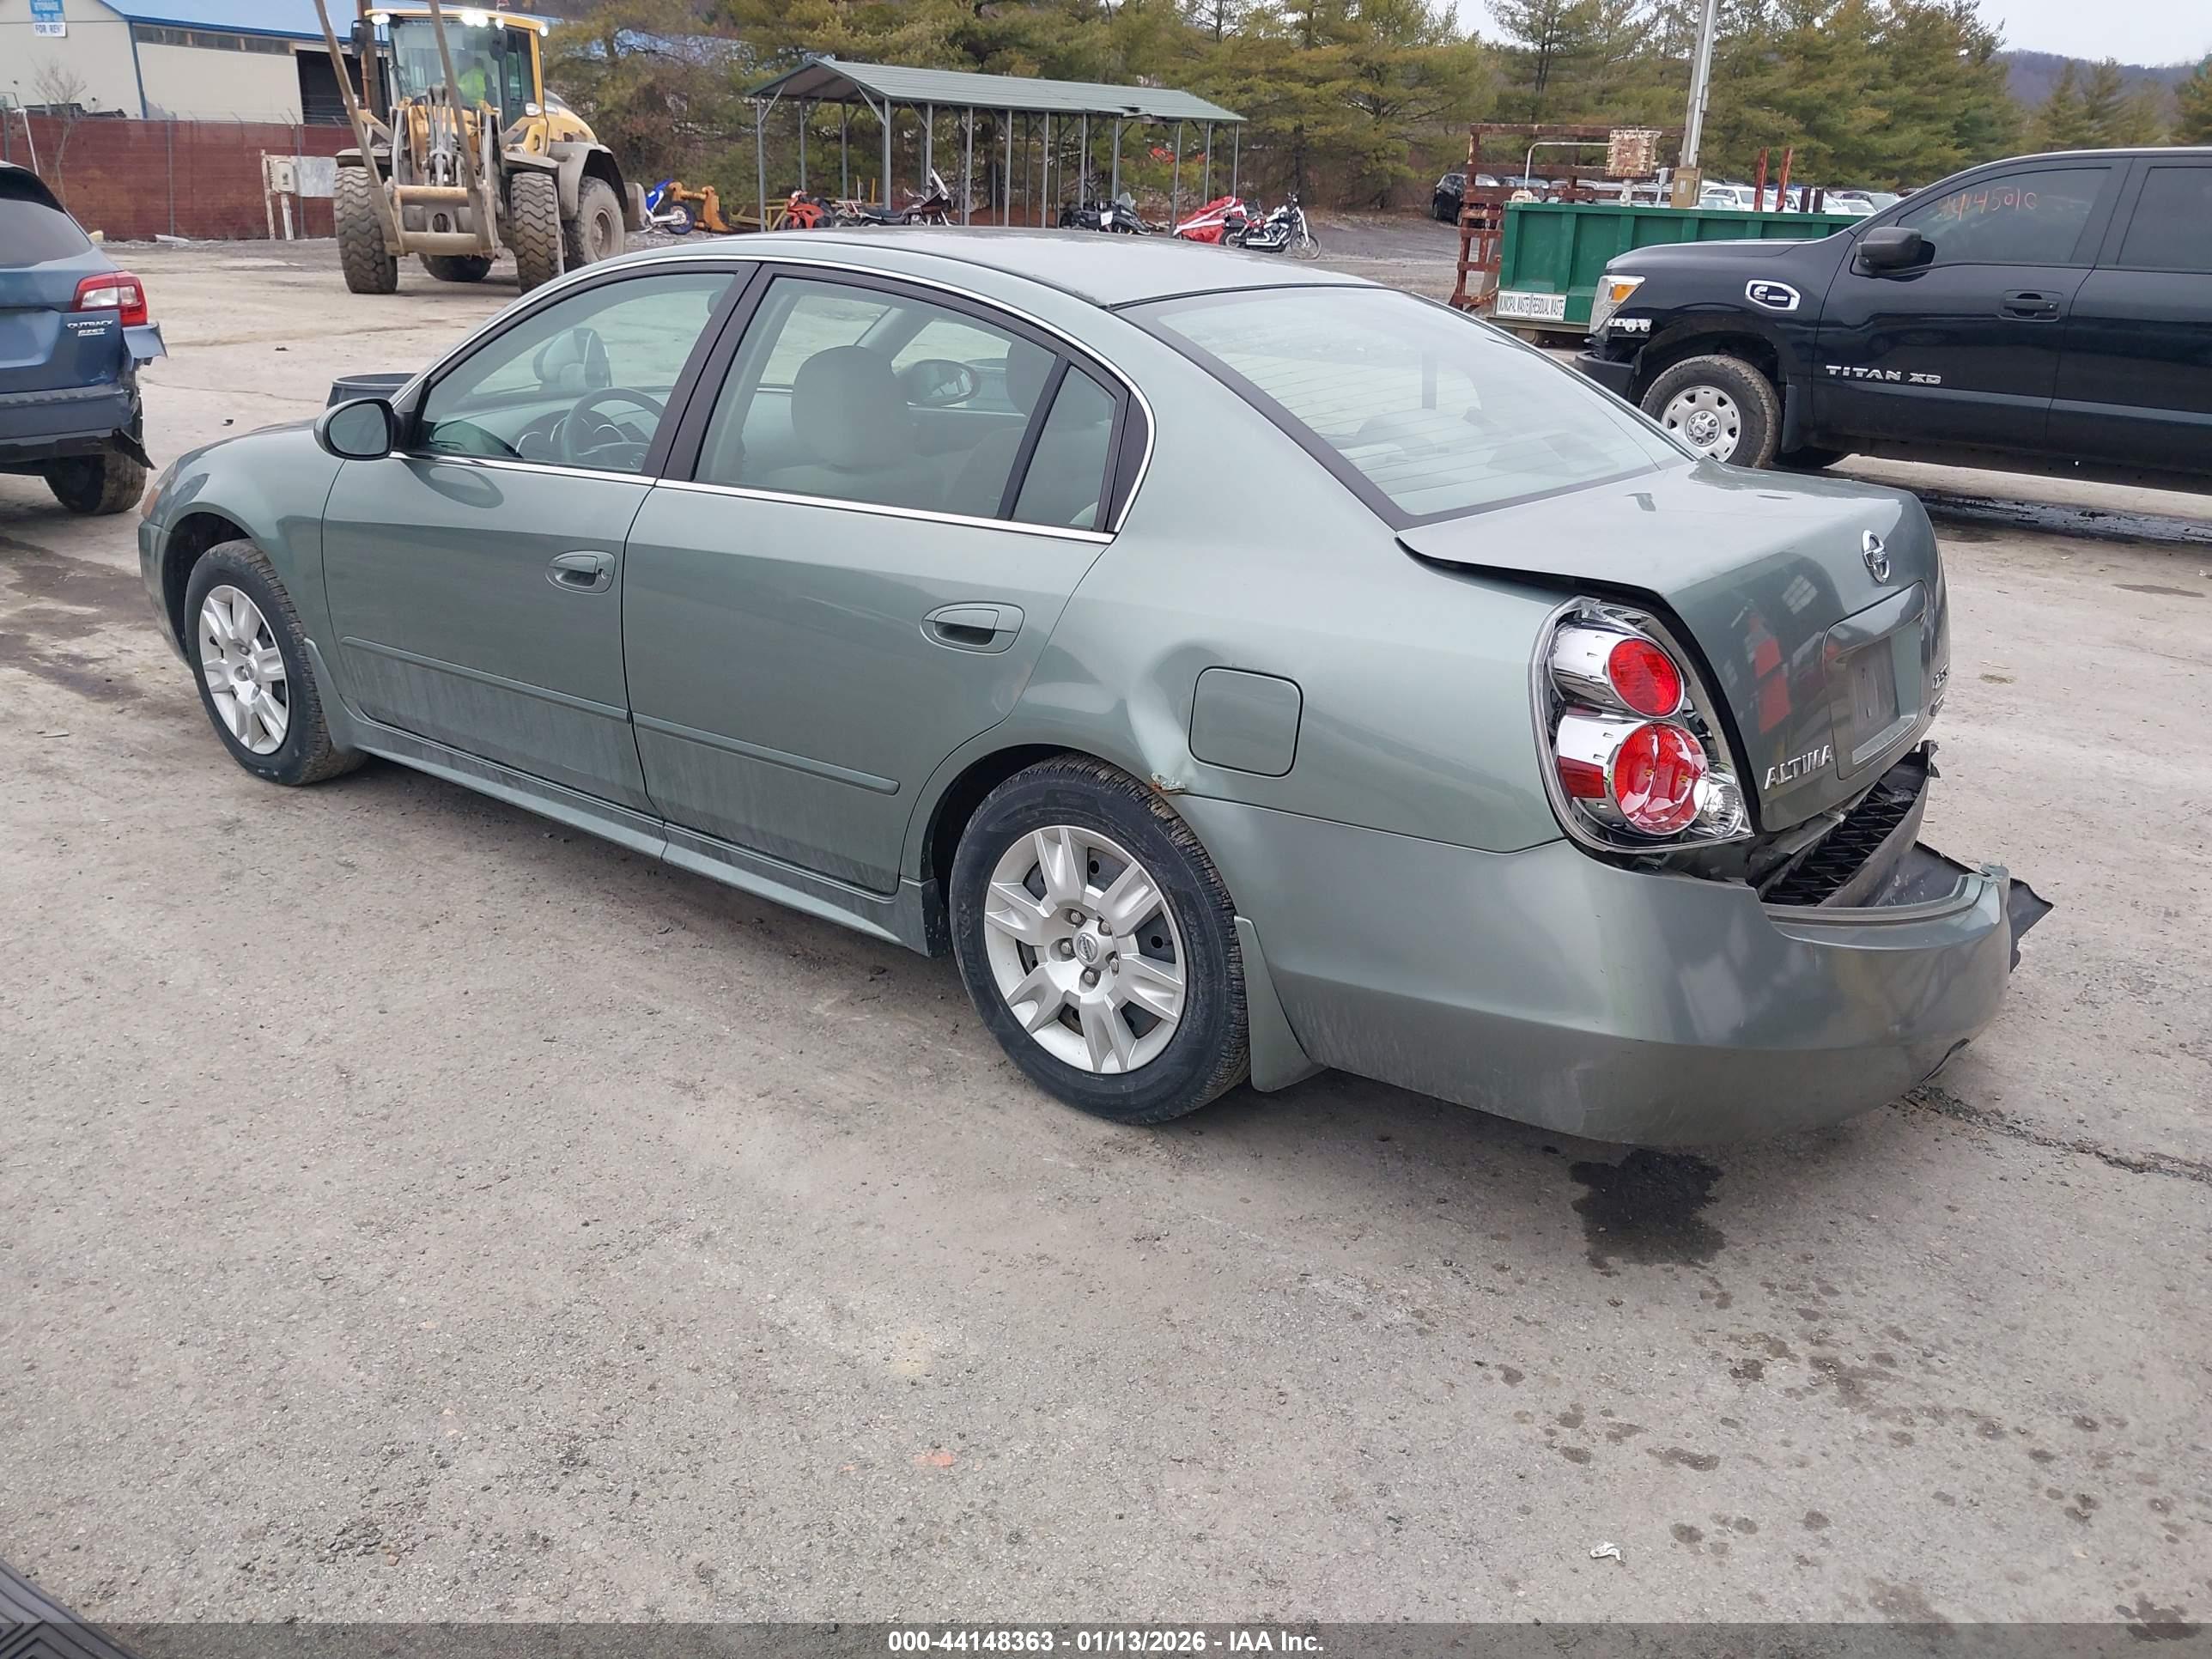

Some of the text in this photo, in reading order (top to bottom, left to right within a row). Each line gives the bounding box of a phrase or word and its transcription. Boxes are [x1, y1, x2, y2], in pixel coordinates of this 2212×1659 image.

[34, 24, 64, 33] FOR RENT
[1498, 295, 1529, 313] MUNICIPAL WASTE
[1551, 299, 1565, 317] WASTE
[67, 319, 113, 329] OUTBACK
[1826, 365, 1942, 384] TITAN XD
[1764, 744, 1833, 790] ALTIMA
